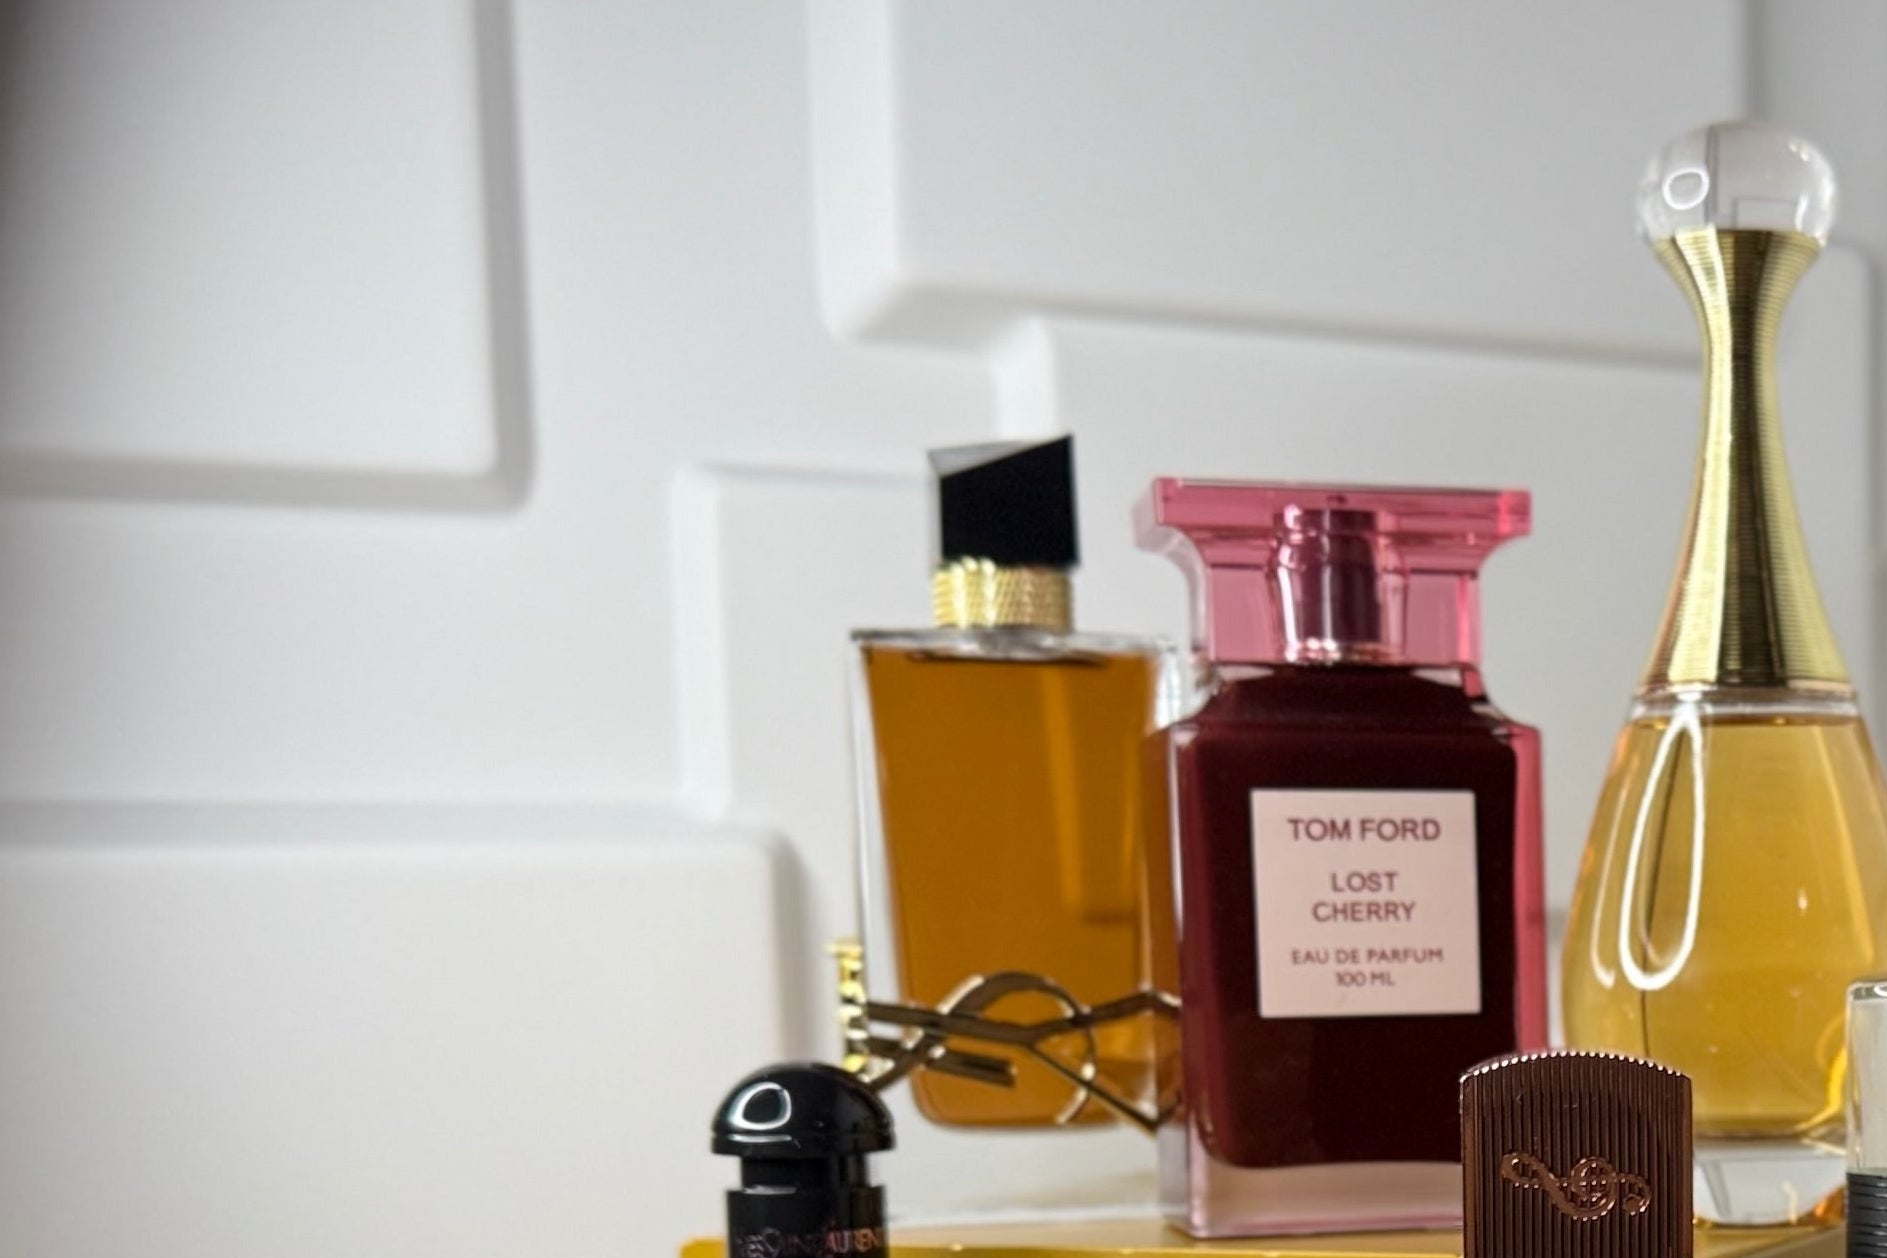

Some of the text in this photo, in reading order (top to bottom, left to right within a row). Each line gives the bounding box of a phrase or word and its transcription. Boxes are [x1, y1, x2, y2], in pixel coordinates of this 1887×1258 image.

[1287, 818, 1442, 842] TOM FORD
[1330, 871, 1399, 893] LOST
[1311, 900, 1416, 923] CHERRY
[1291, 947, 1444, 965] EAU DE PARFUM
[1335, 971, 1396, 988] 100 ML
